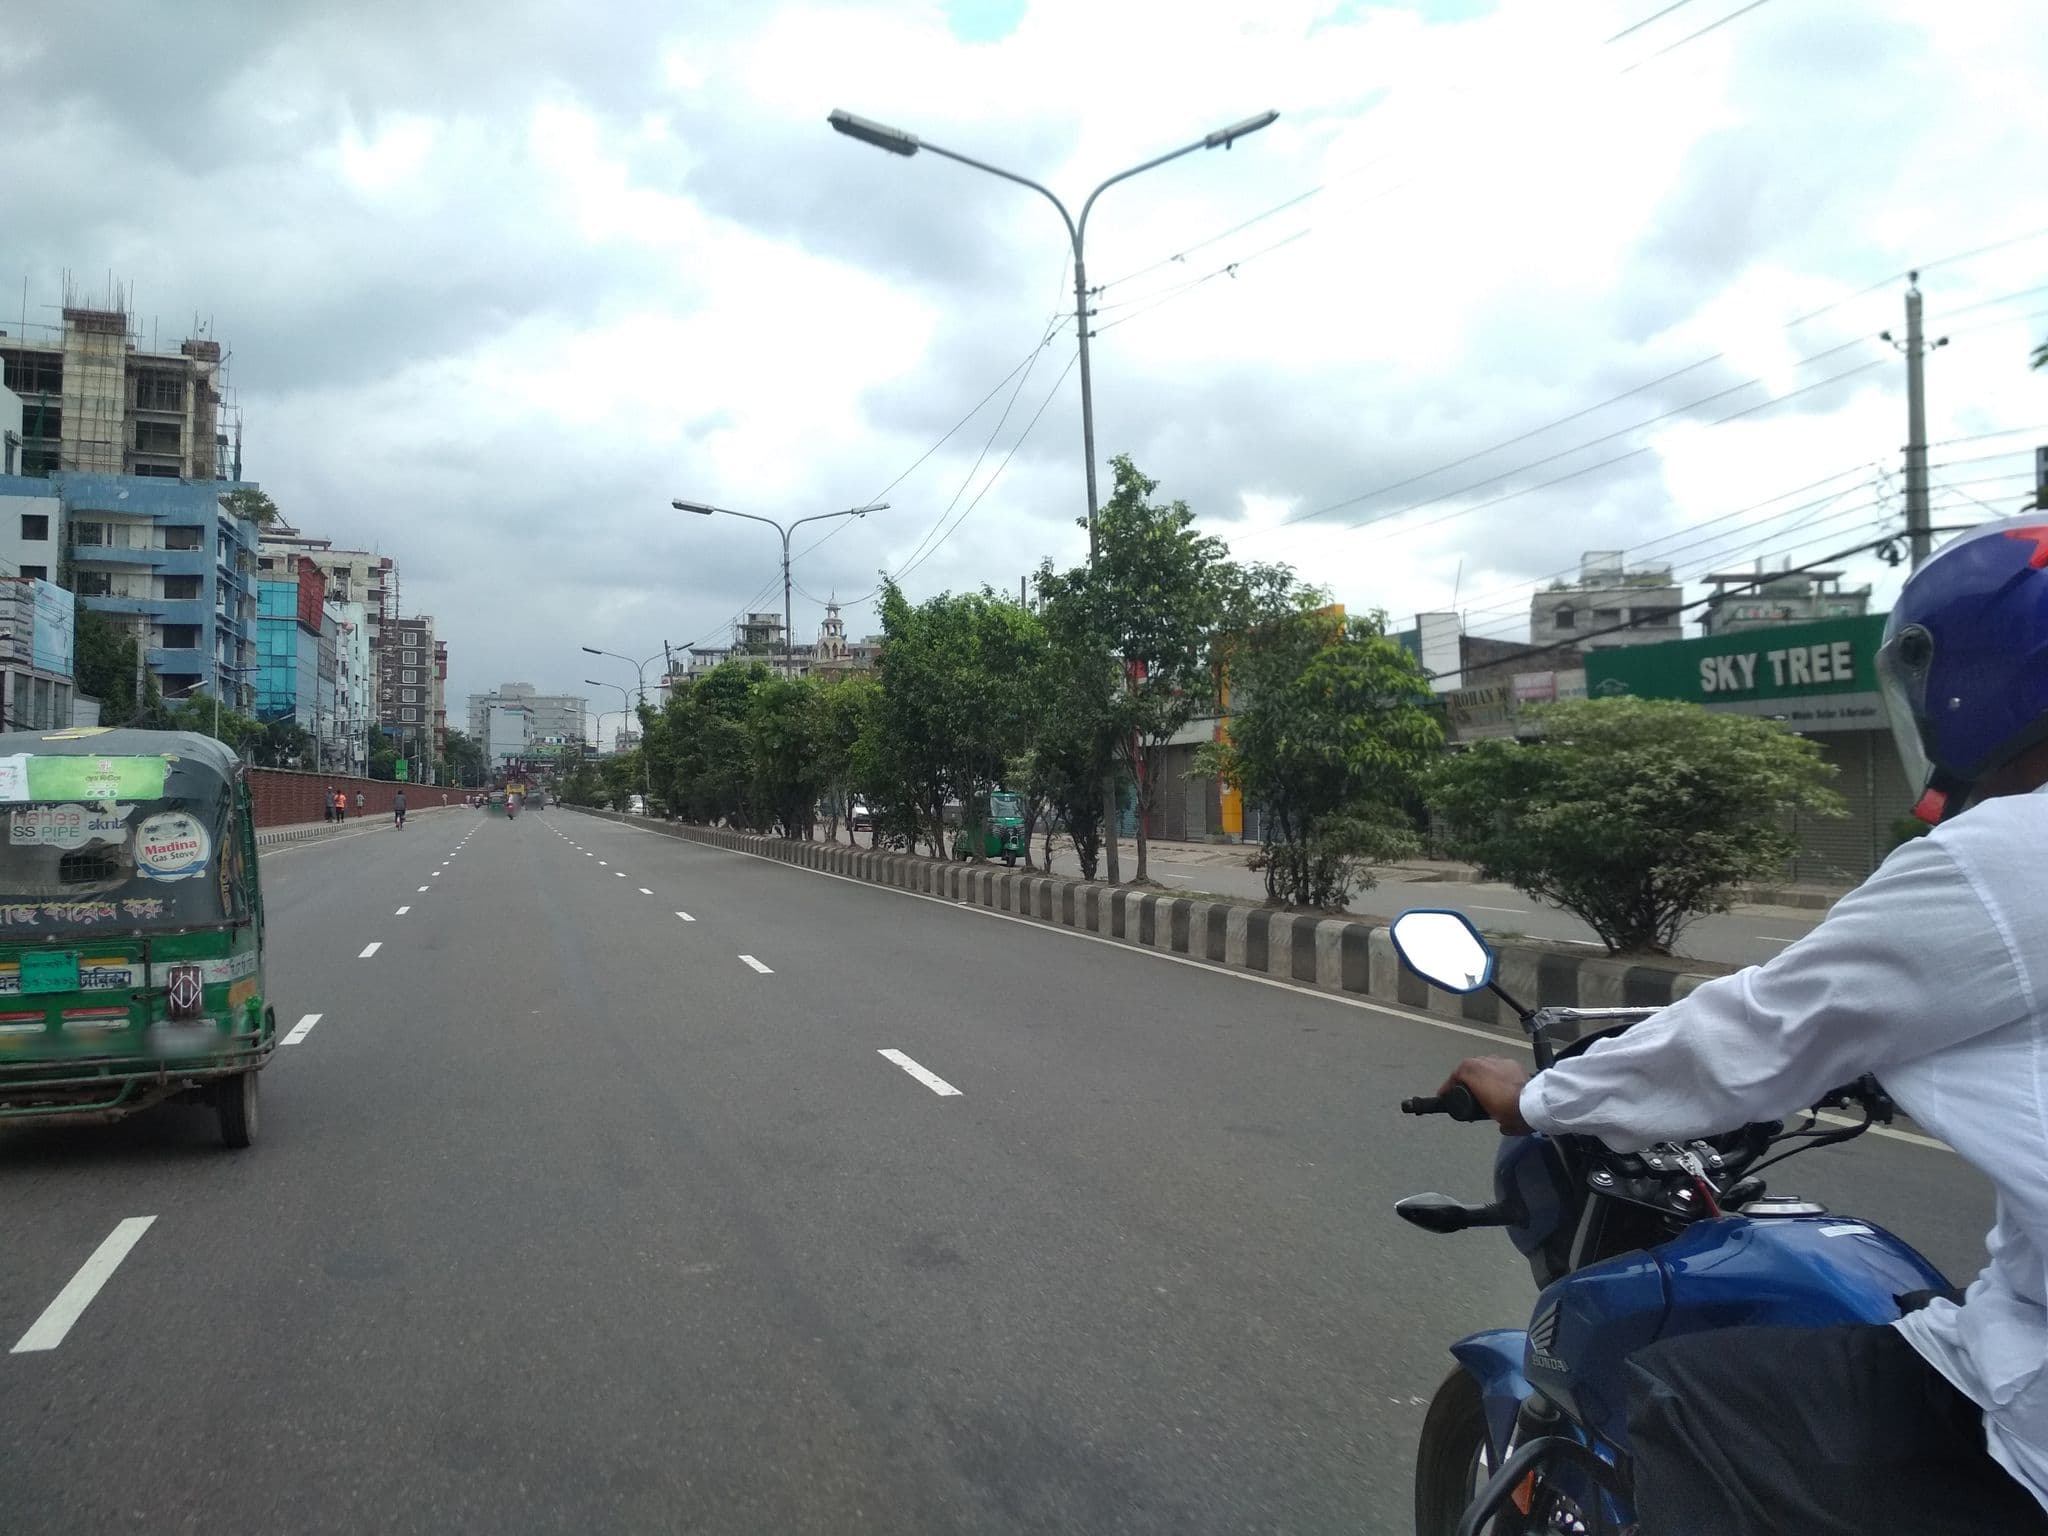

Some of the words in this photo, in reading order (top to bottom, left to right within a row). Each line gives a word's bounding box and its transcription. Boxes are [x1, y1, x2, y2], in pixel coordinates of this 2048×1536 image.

[1700, 652, 1757, 693] SKY
[1768, 641, 1853, 687] TREE
[13, 826, 36, 838] SS
[42, 827, 80, 838] PIPE
[145, 841, 197, 855] Madina
[152, 855, 167, 863] Gas
[170, 851, 195, 860] Stove
[1532, 1356, 1570, 1373] HONDA
